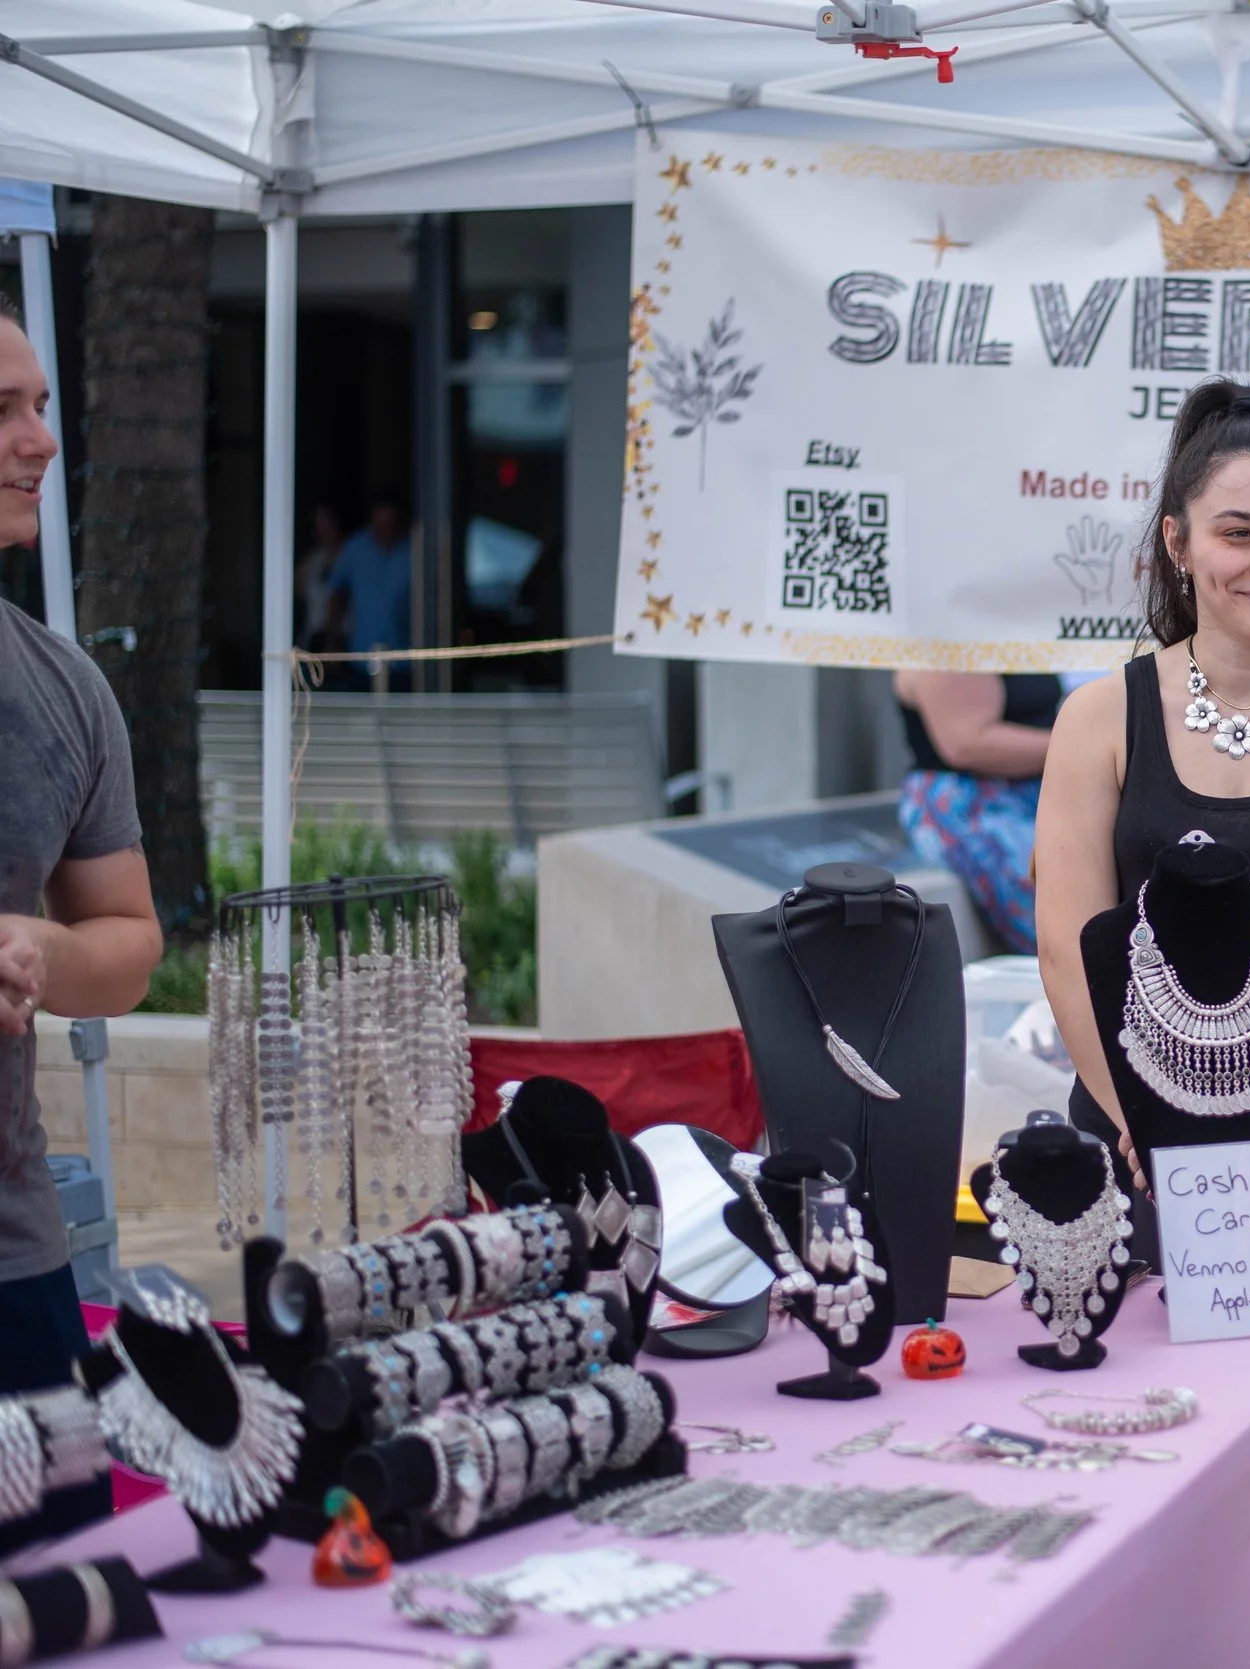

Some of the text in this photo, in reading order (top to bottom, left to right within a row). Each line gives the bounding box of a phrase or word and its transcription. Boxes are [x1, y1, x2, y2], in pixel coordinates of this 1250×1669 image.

[805, 439, 861, 470] Etsy
[1022, 471, 1108, 499] Made
[1122, 473, 1151, 501] in
[1168, 1166, 1248, 1196] Cash
[1169, 1249, 1247, 1277] Venmo
